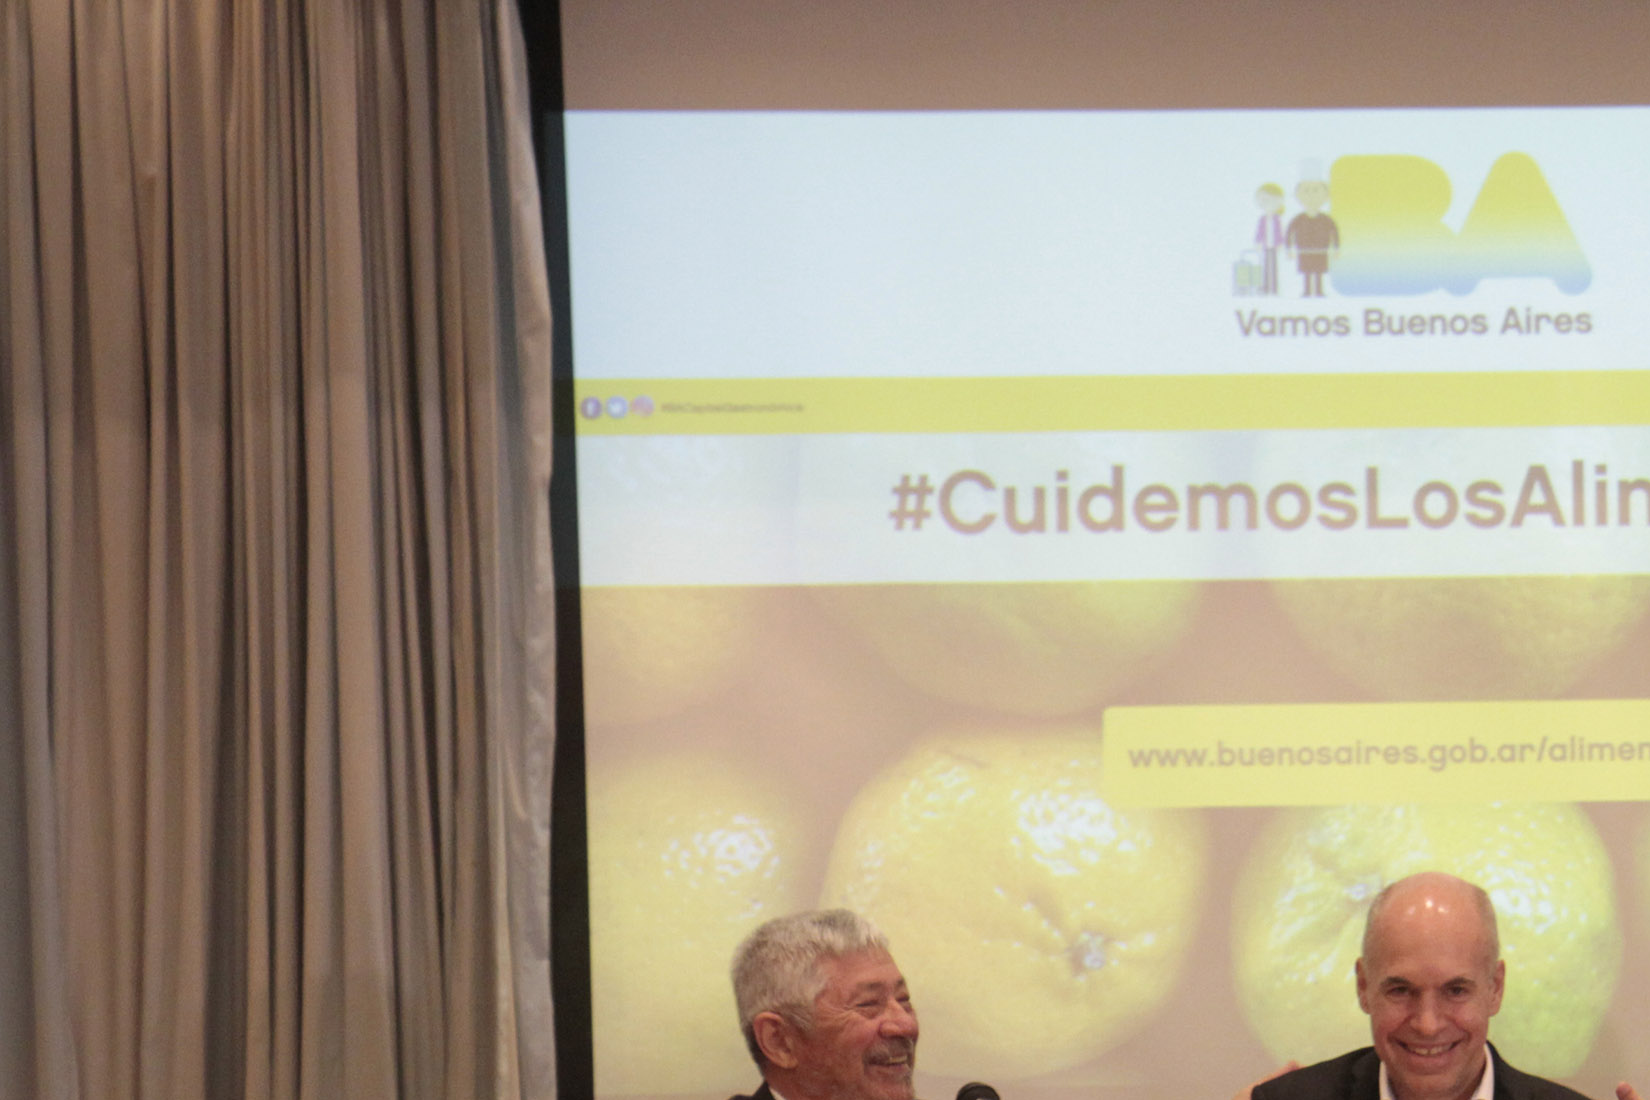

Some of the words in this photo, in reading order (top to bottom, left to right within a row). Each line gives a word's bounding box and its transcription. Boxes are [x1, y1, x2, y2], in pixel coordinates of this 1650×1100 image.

[1329, 150, 1593, 296] BA
[1235, 310, 1351, 337] Vamos
[1362, 308, 1489, 337] Buenos
[1500, 307, 1593, 335] Aires
